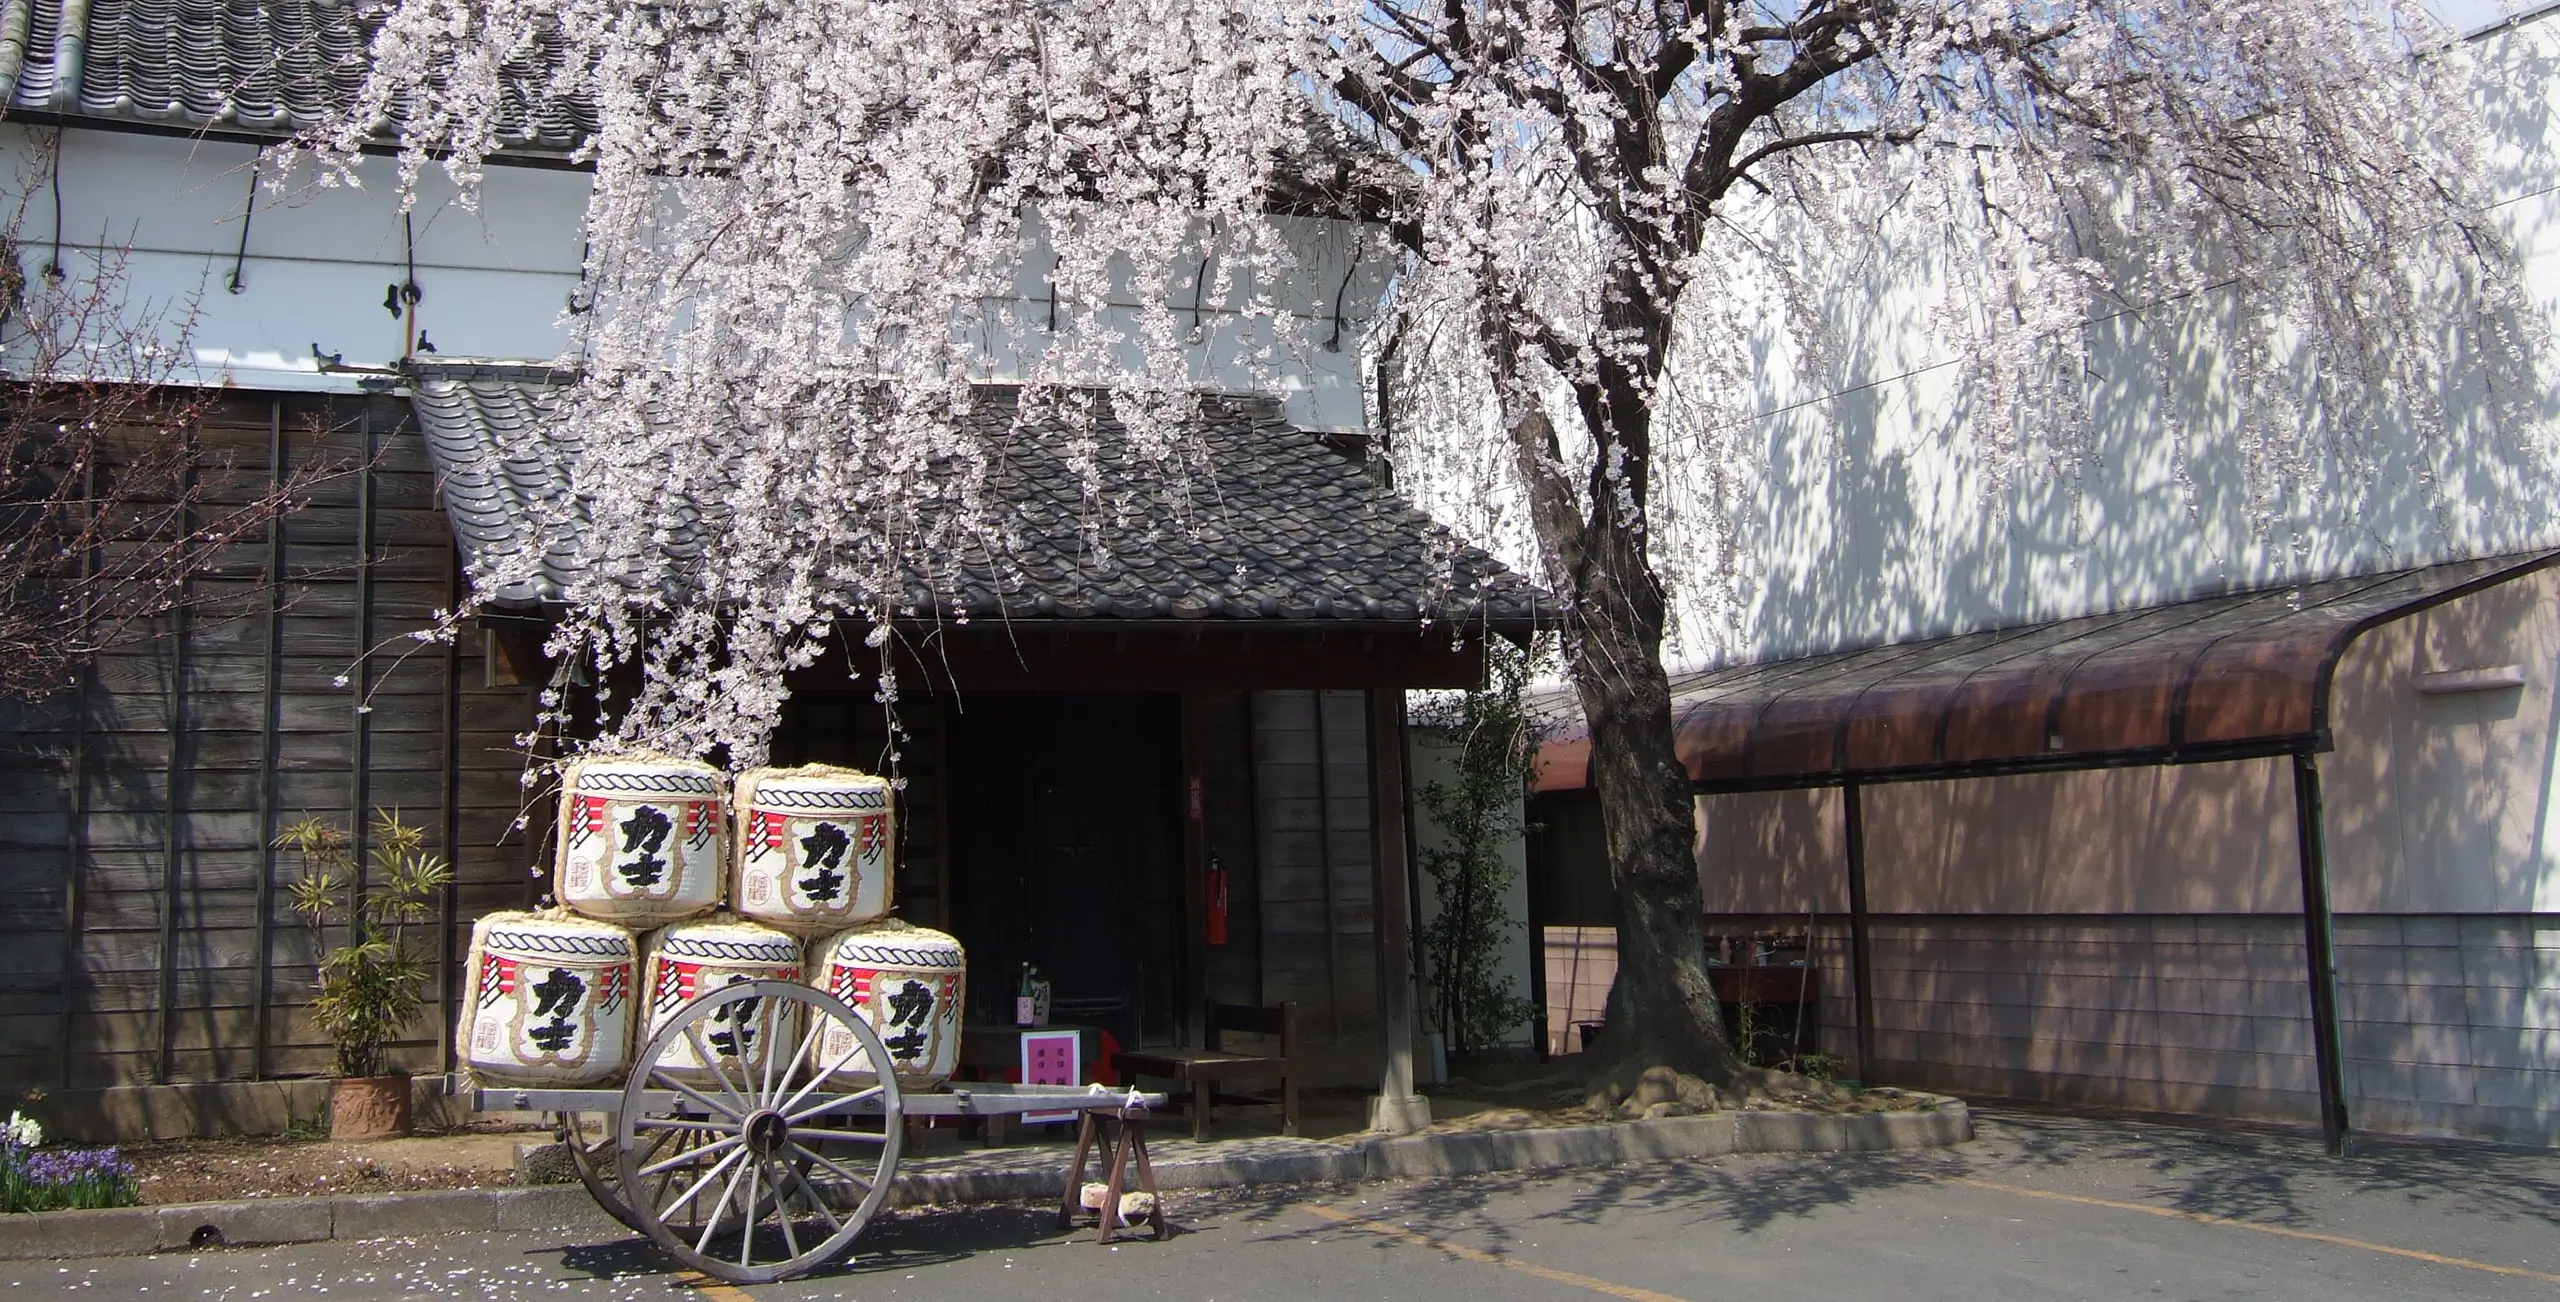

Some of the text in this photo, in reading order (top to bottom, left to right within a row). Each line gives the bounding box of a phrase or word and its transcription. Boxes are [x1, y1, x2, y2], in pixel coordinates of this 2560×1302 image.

[618, 805, 673, 886] 力士
[798, 822, 851, 901] 力士
[528, 967, 586, 1051] 力士
[885, 980, 935, 1060] 力士
